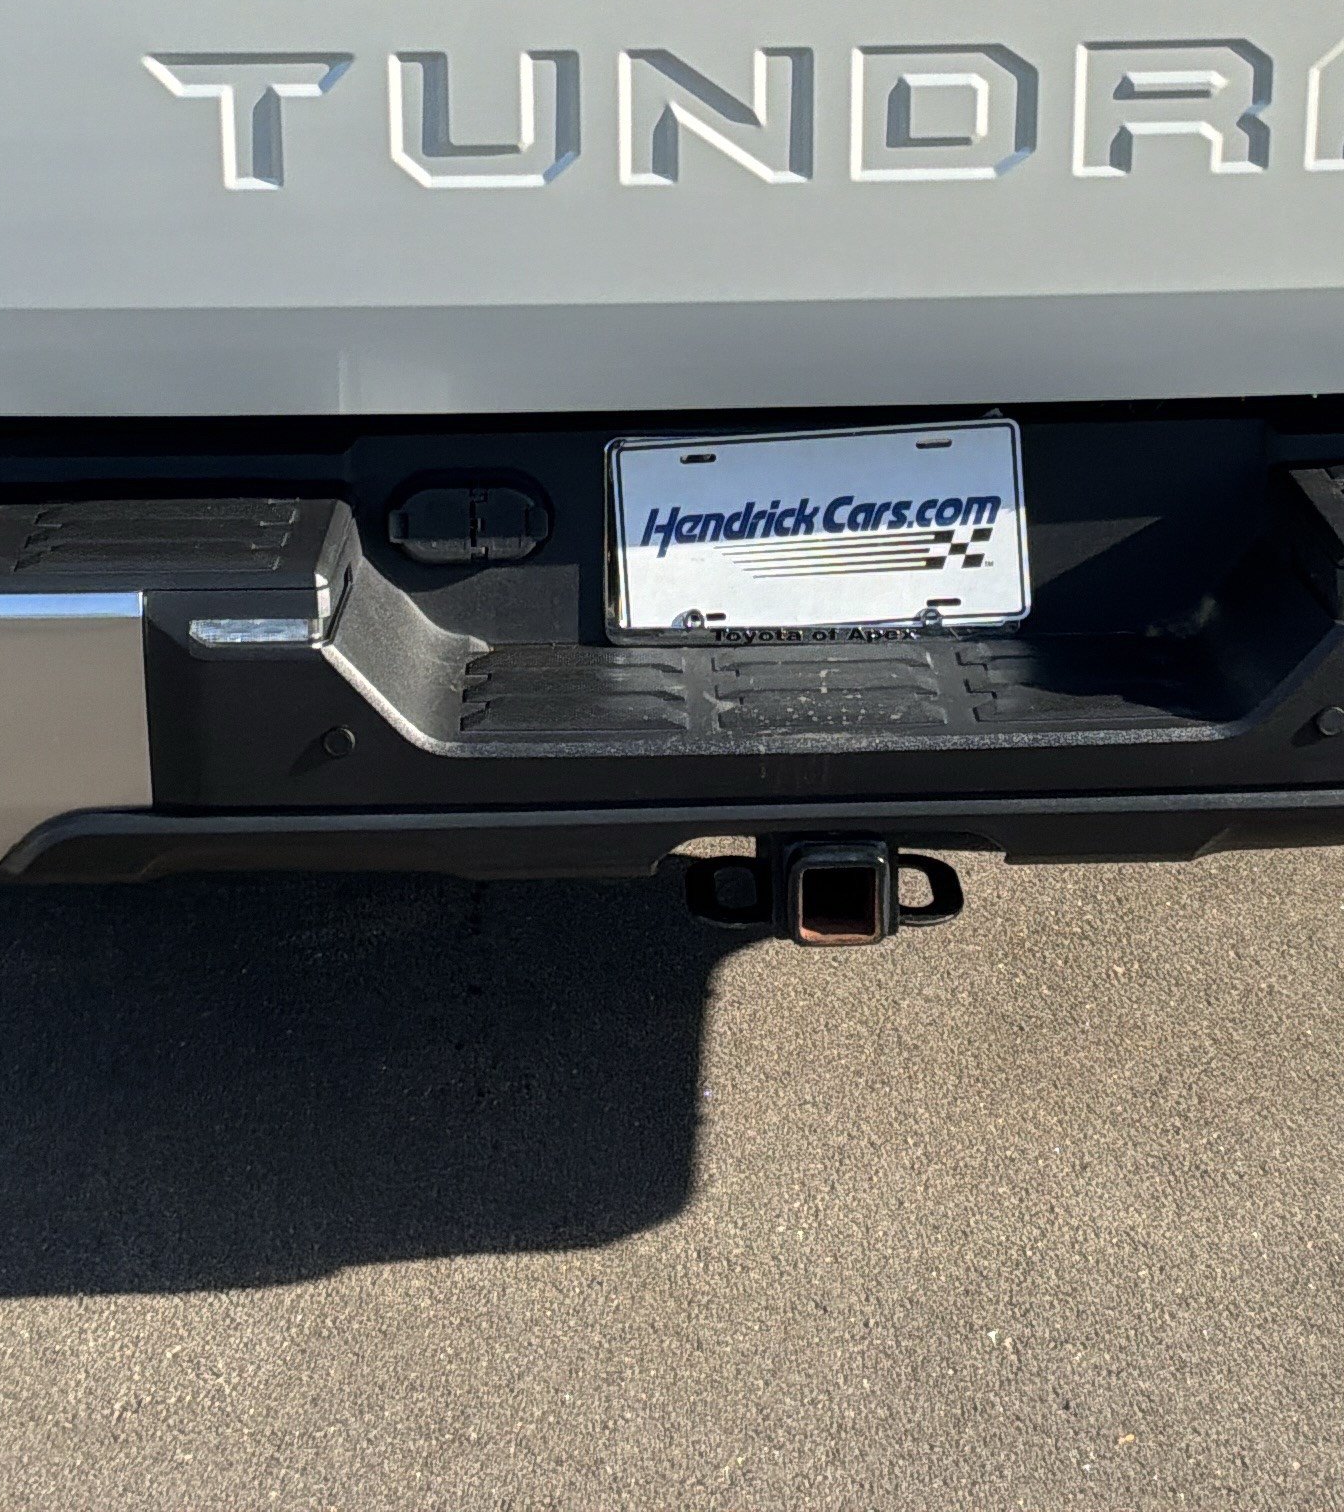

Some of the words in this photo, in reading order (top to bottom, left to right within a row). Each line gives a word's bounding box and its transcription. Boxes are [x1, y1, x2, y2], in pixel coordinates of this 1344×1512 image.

[711, 627, 803, 644] Toyota
[811, 627, 836, 642] of
[847, 627, 918, 643] Apex
